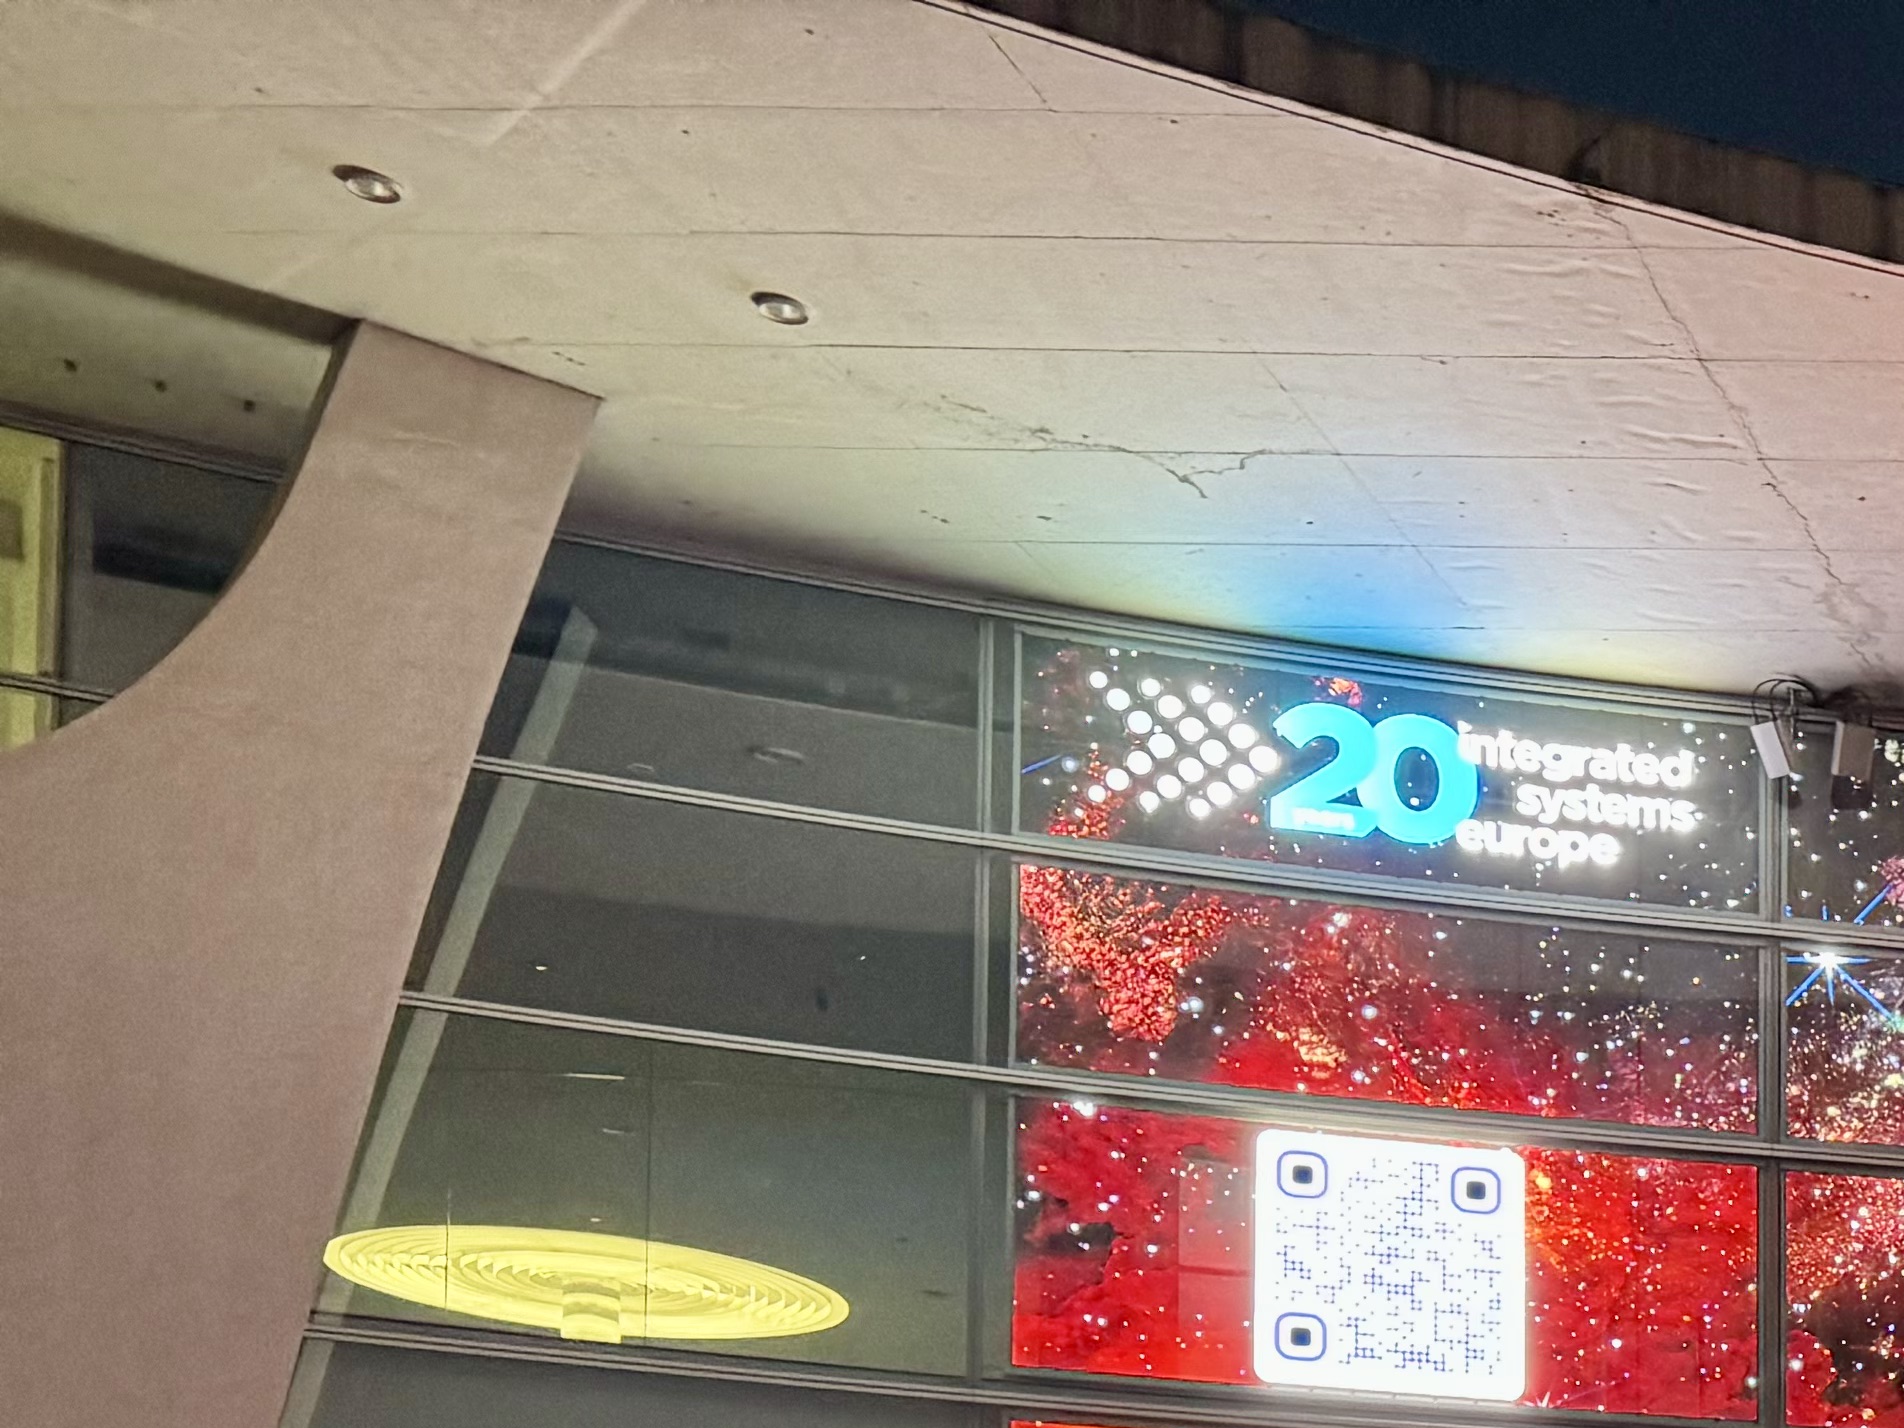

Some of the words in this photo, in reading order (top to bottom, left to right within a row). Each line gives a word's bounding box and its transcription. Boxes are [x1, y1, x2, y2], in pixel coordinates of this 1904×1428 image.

[1270, 702, 1479, 844] 20
[1457, 720, 1696, 788] integrated
[1515, 783, 1697, 832] systems
[1455, 818, 1622, 869] europe
